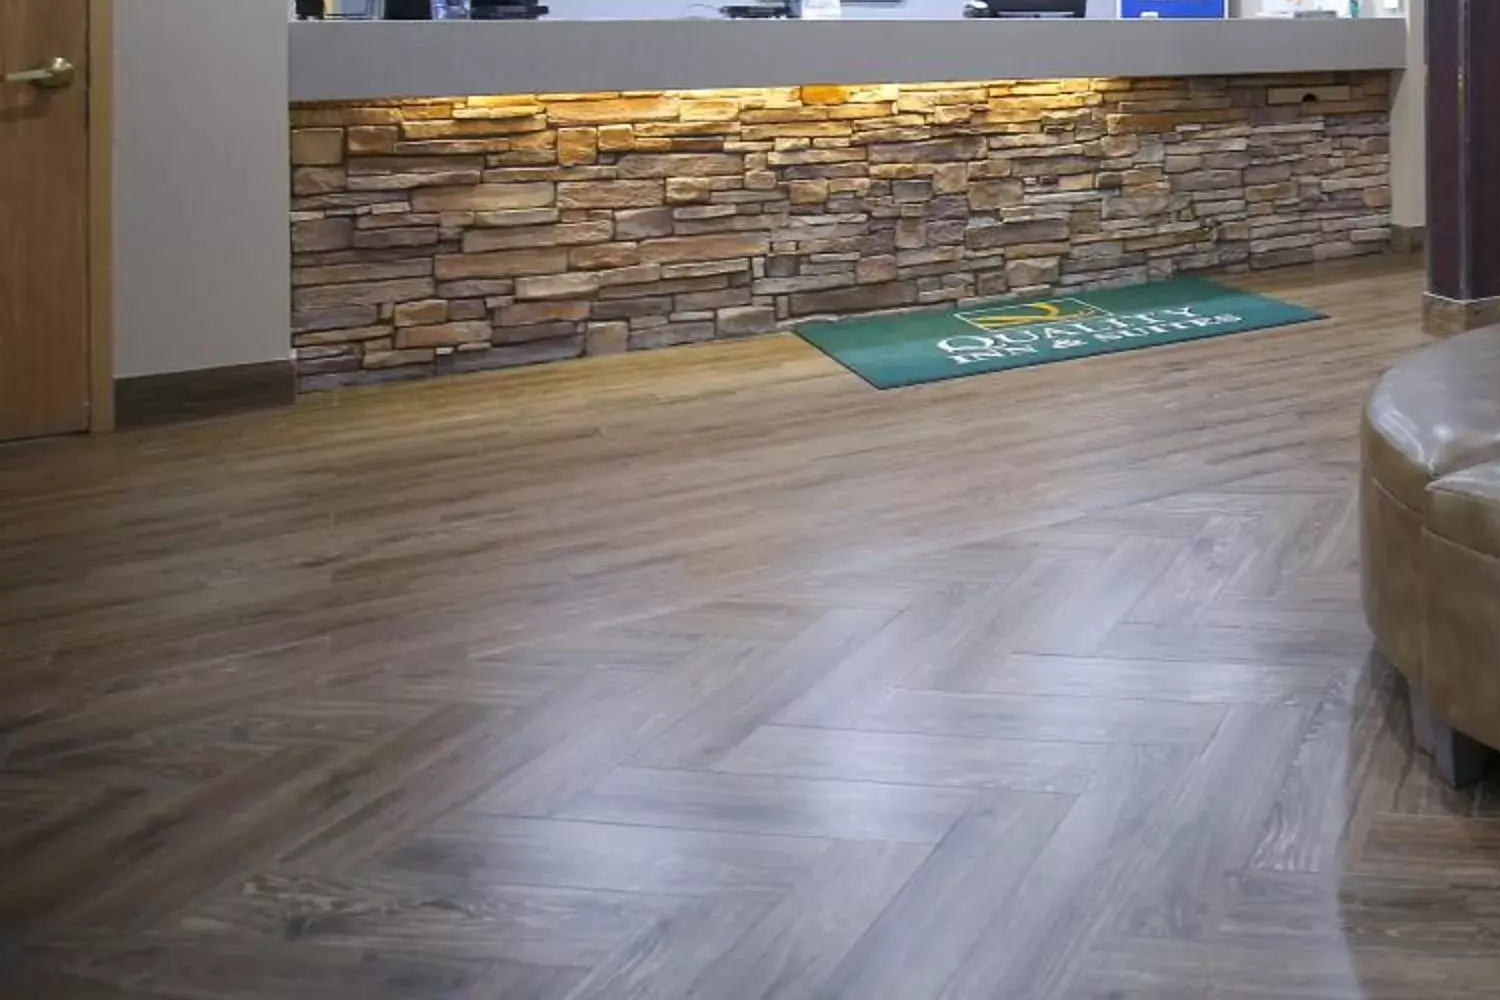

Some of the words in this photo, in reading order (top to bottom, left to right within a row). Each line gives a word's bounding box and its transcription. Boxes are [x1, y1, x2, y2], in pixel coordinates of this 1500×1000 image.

[936, 304, 1199, 354] QUALITY
[947, 343, 1039, 366] INN
[1050, 337, 1088, 350] &
